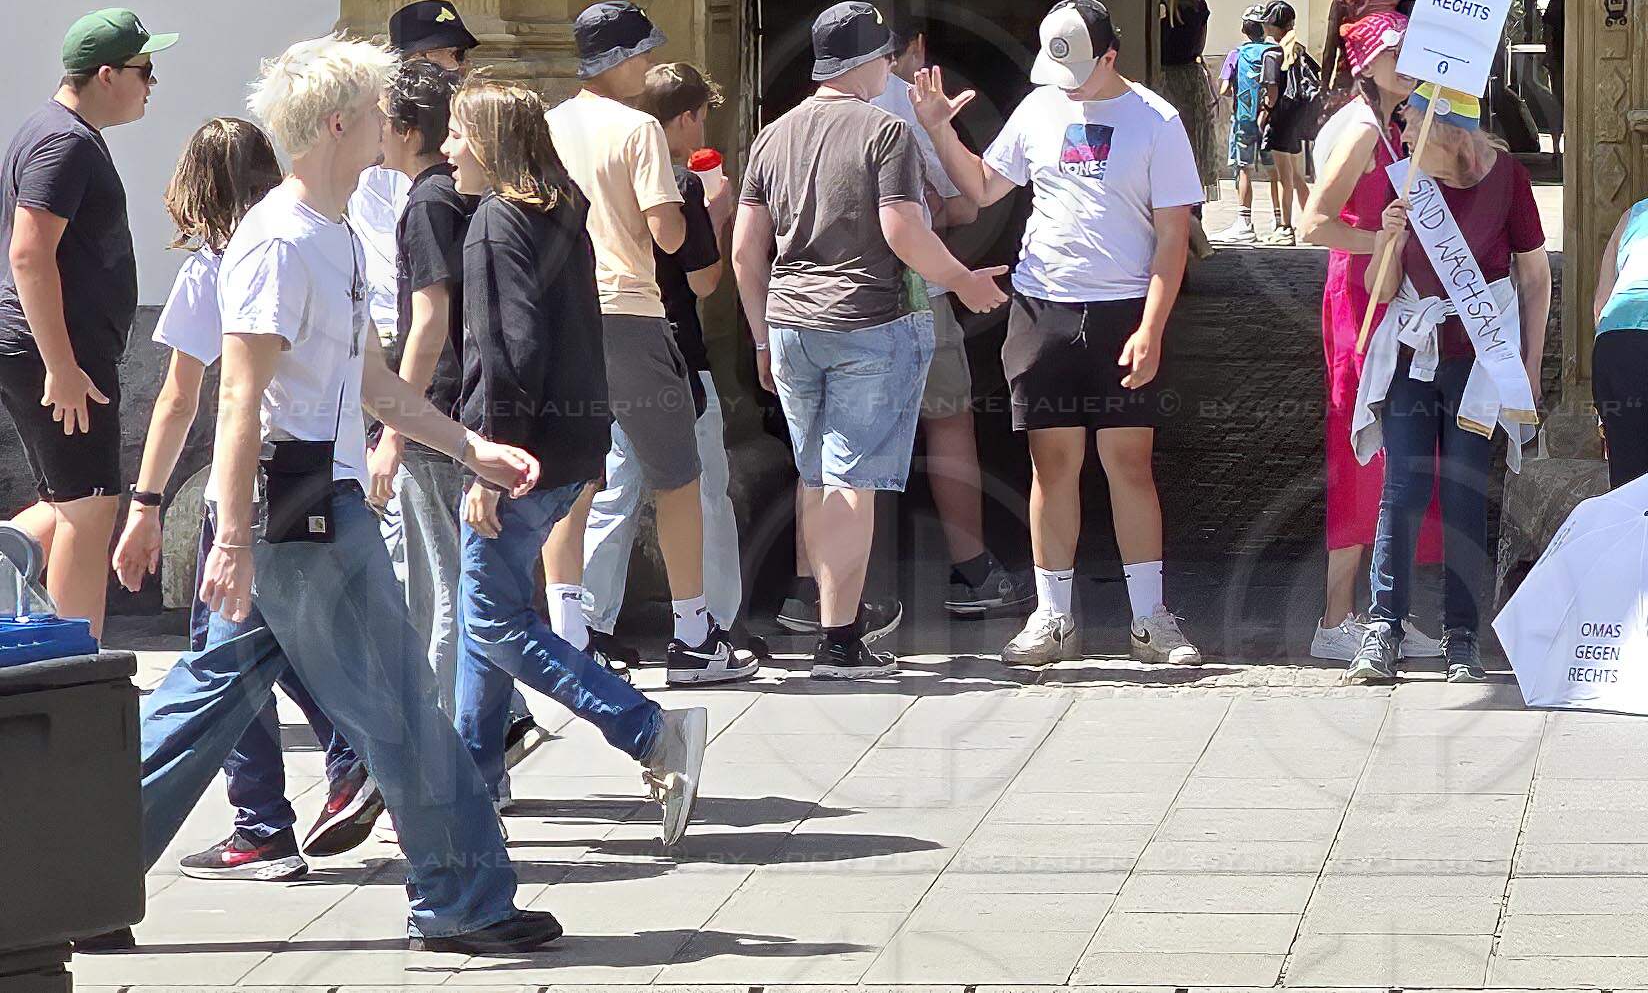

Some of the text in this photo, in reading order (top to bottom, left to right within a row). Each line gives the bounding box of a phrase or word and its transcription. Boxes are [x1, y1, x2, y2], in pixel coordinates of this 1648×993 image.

[1580, 623, 1622, 638] OMAS
[1575, 645, 1621, 661] GEGEN
[1568, 667, 1618, 684] RECHTS
